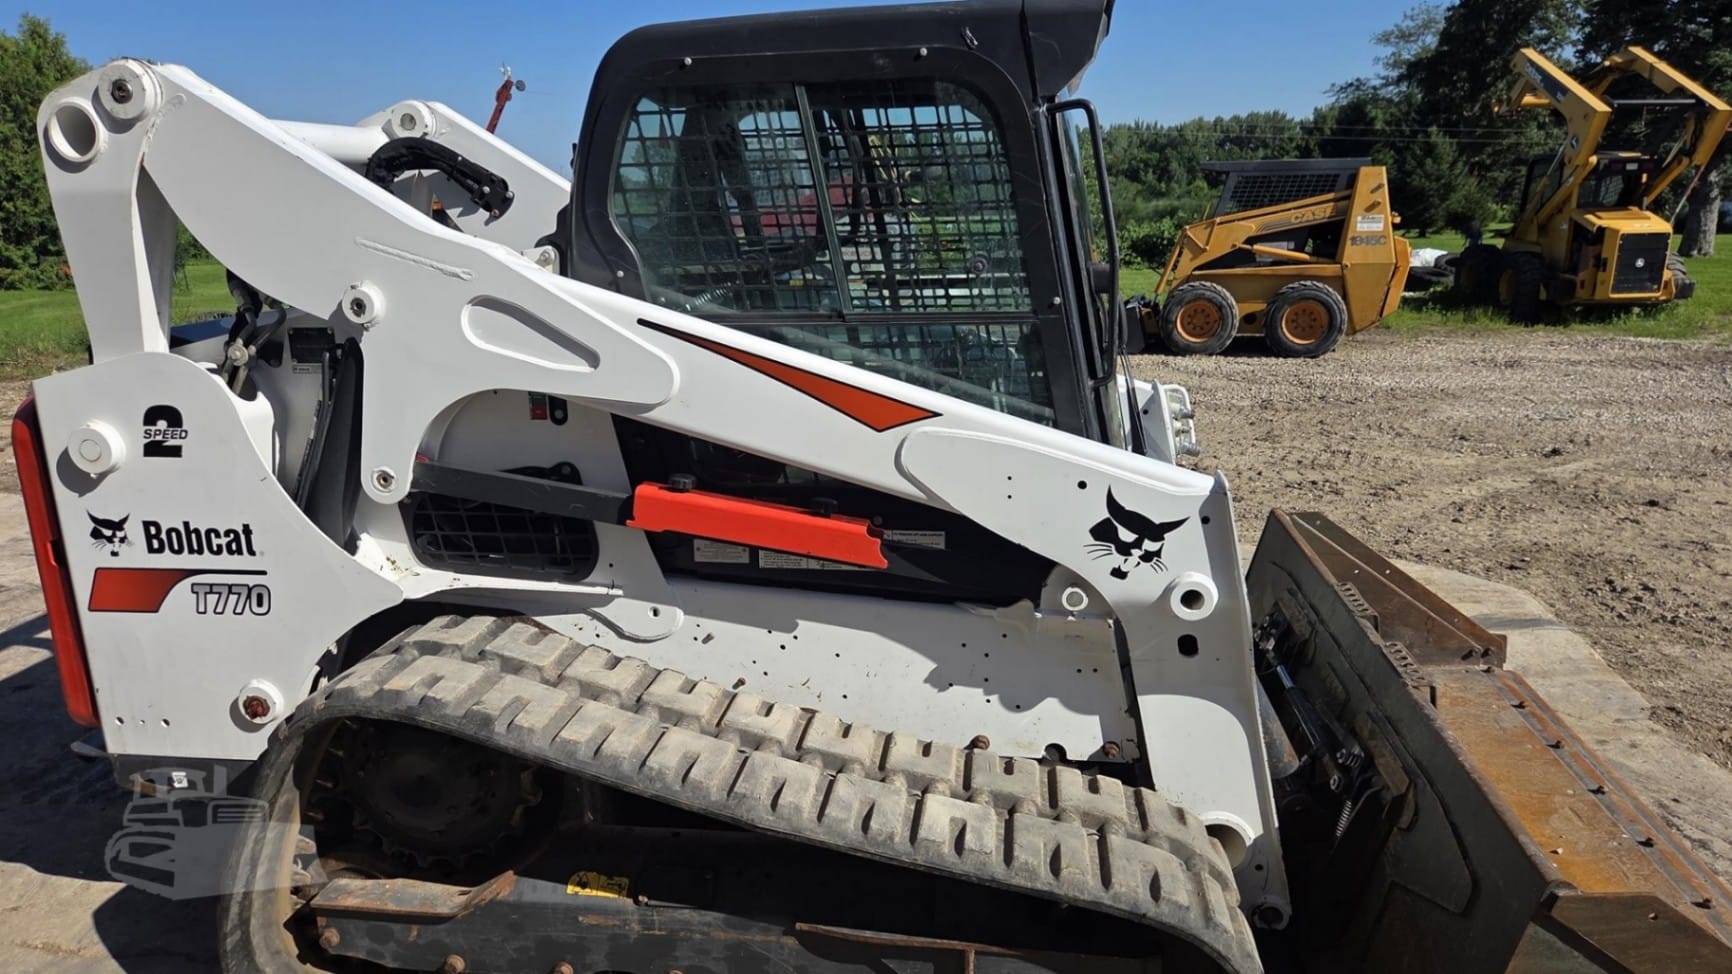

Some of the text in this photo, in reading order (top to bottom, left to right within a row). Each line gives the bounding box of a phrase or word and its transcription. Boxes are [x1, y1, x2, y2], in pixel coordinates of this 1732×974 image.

[143, 404, 183, 458] 2
[143, 428, 189, 440] SPEED
[142, 520, 257, 557] Bobcat
[190, 582, 272, 617] T770
